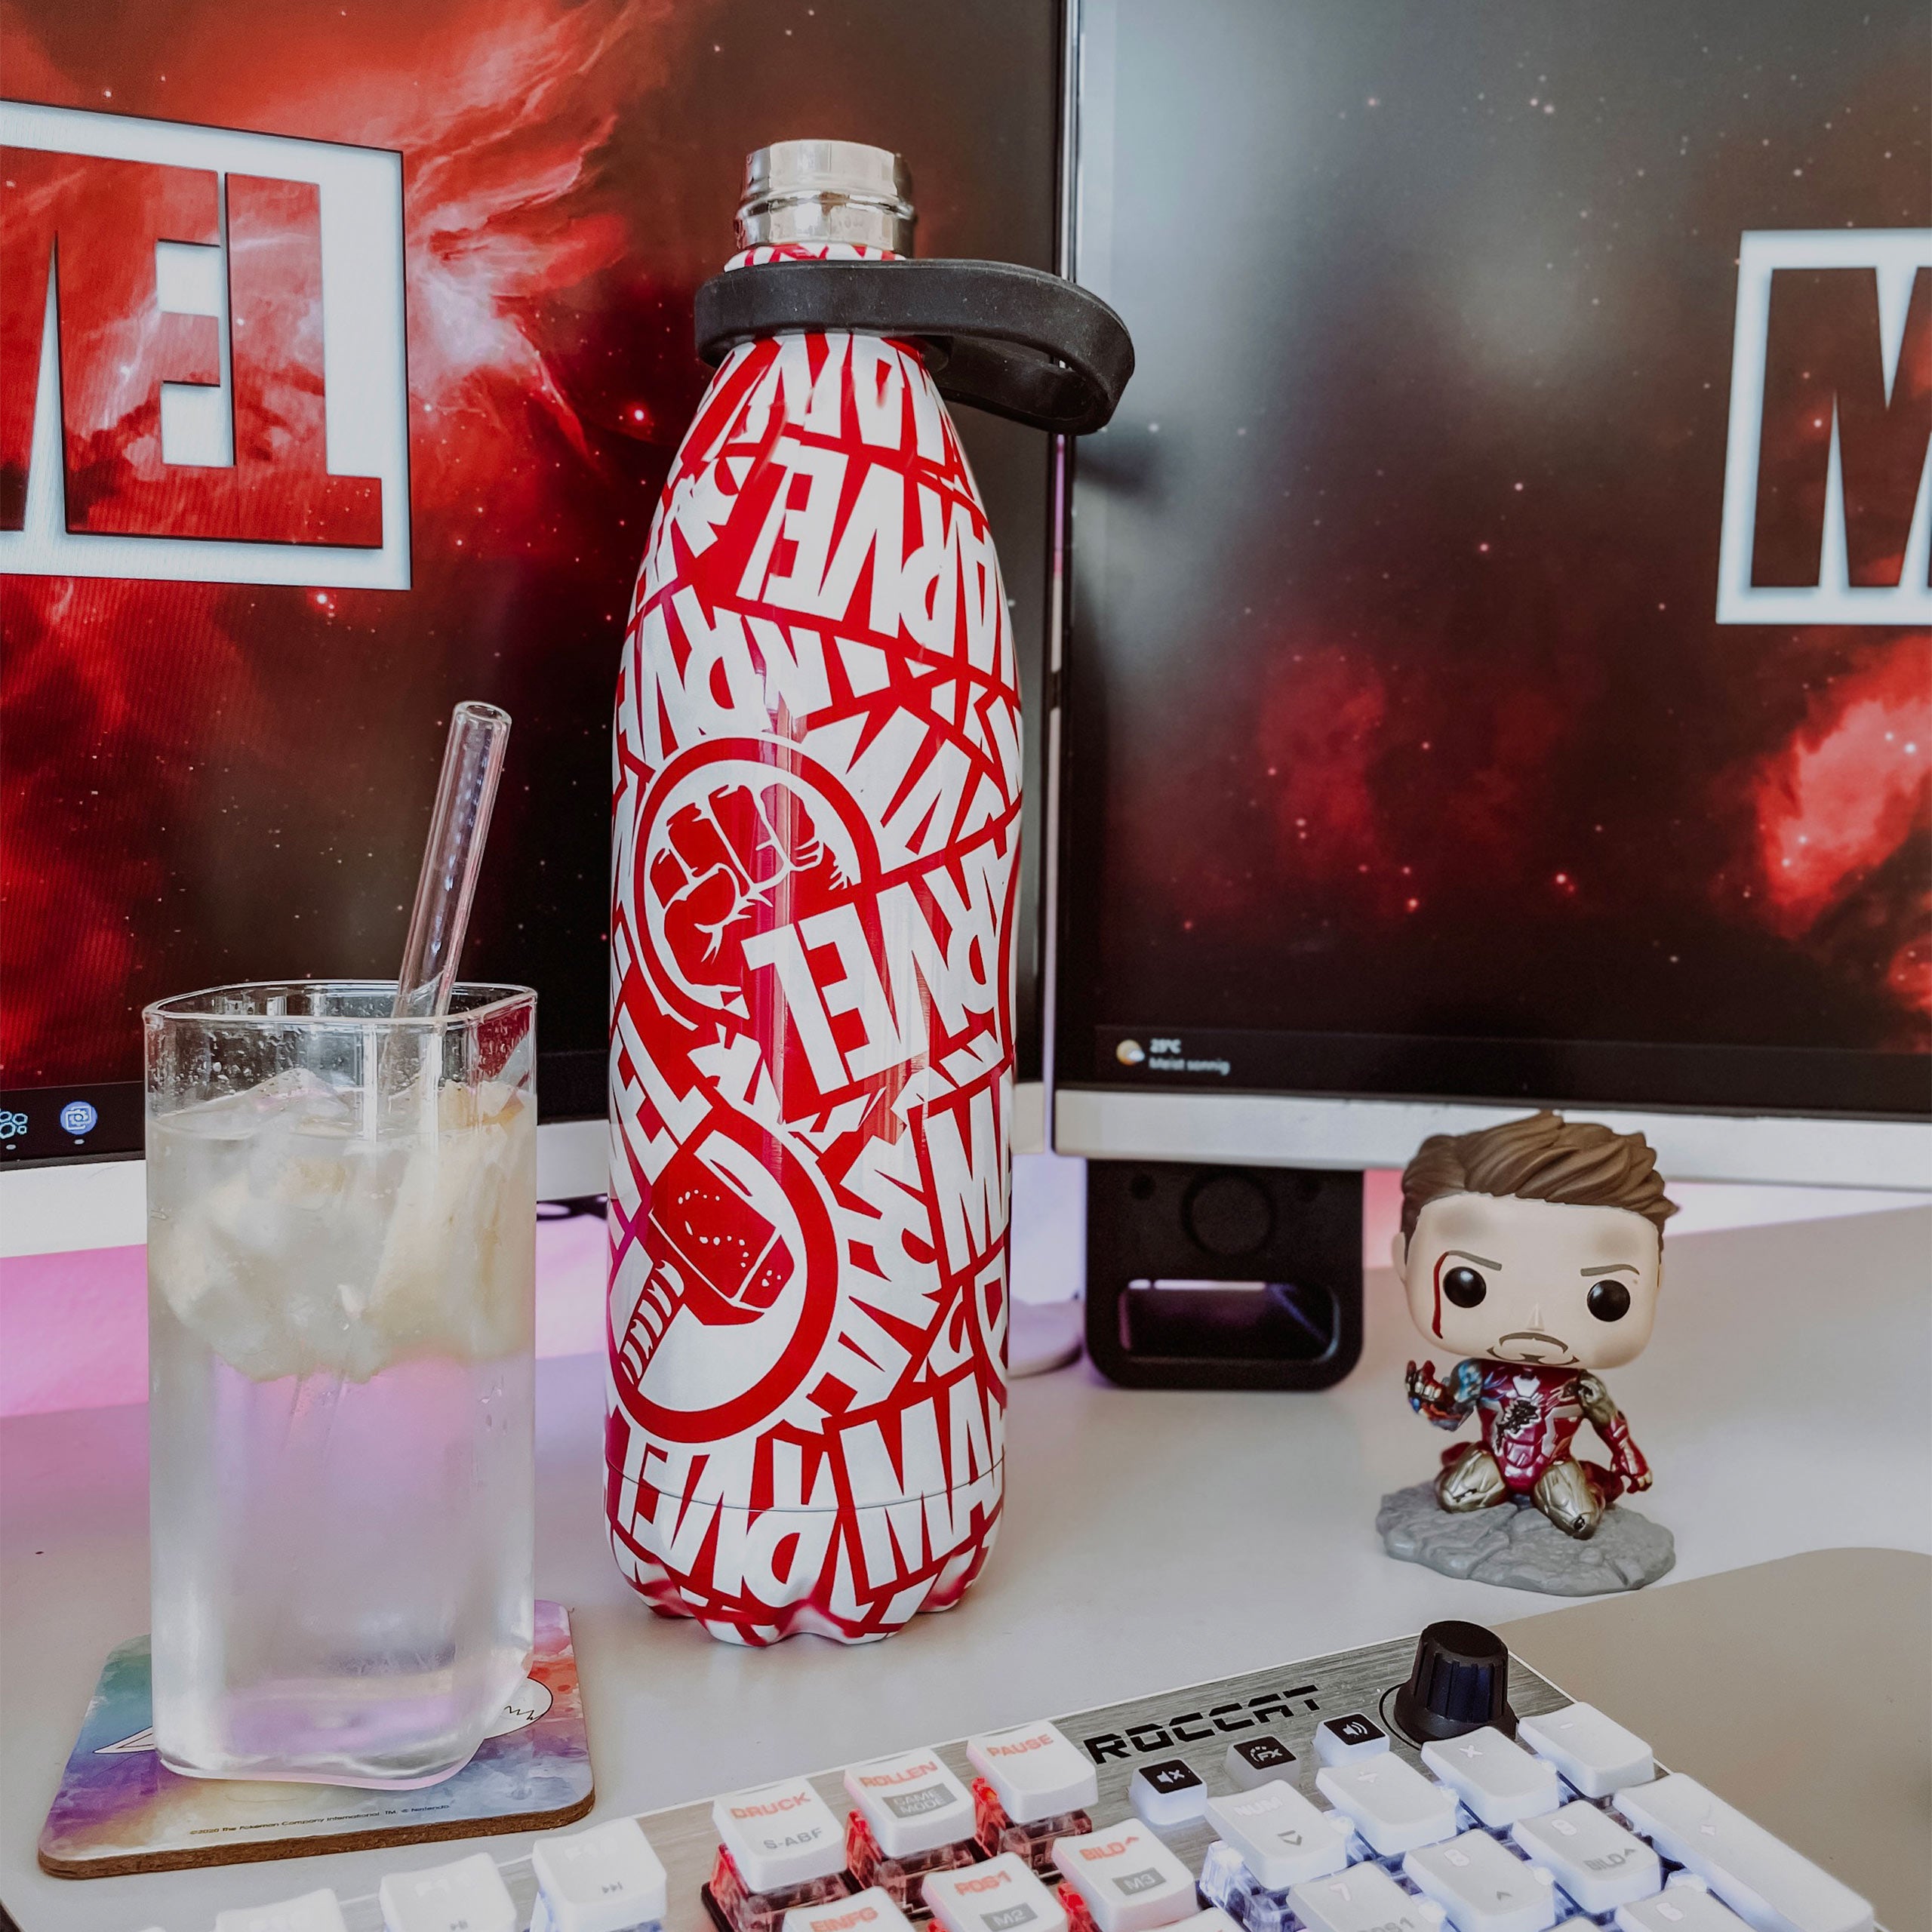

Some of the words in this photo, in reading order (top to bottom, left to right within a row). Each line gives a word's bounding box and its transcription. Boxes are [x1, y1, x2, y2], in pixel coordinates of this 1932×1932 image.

[1083, 1684, 1321, 1764] ROCCAT
[986, 1734, 1054, 1758] PAUSE
[860, 1760, 938, 1788] ROLLEN
[730, 1792, 811, 1819] DRUCK
[281, 1818, 325, 1826] Company
[763, 1827, 822, 1849] S-ABF
[1124, 1874, 1155, 1889] M3
[993, 1909, 1025, 1927] M2
